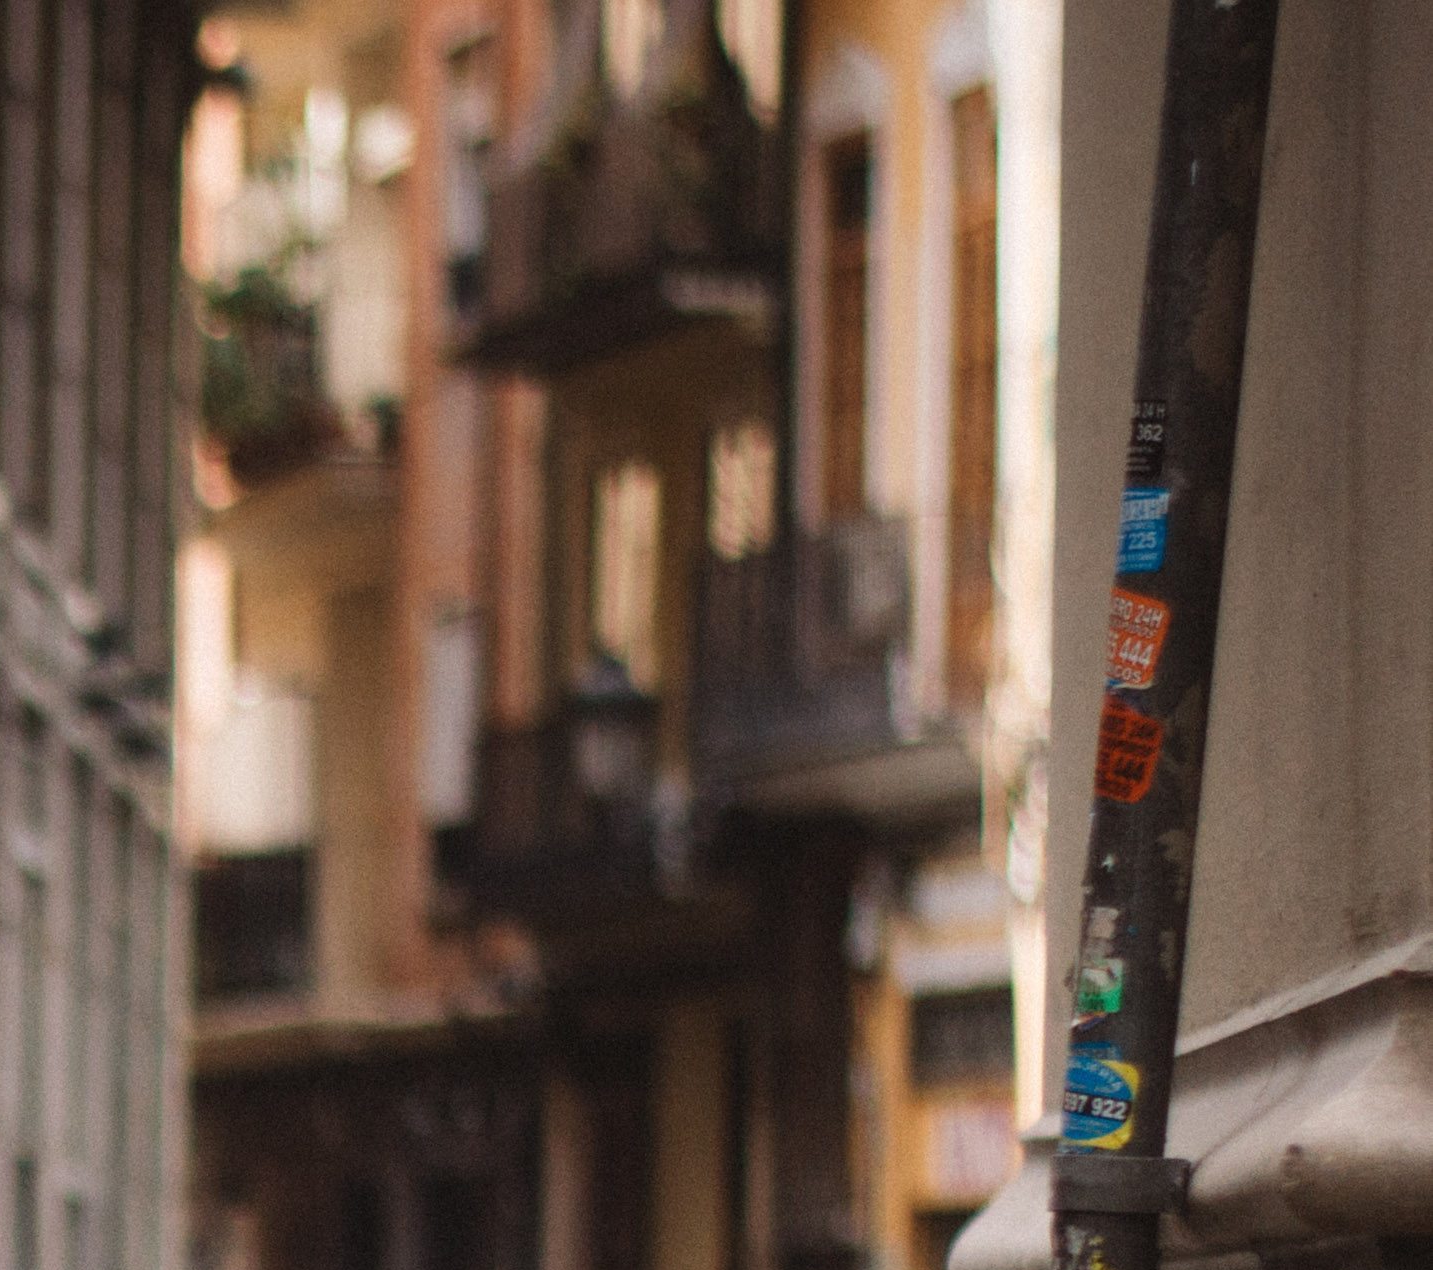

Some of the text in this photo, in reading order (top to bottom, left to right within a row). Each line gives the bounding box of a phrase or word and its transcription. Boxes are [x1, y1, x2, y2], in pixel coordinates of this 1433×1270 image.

[1128, 530, 1158, 551] 225
[1134, 604, 1165, 629] 24H
[1119, 637, 1155, 670] 444
[1090, 1096, 1128, 1122] 922
